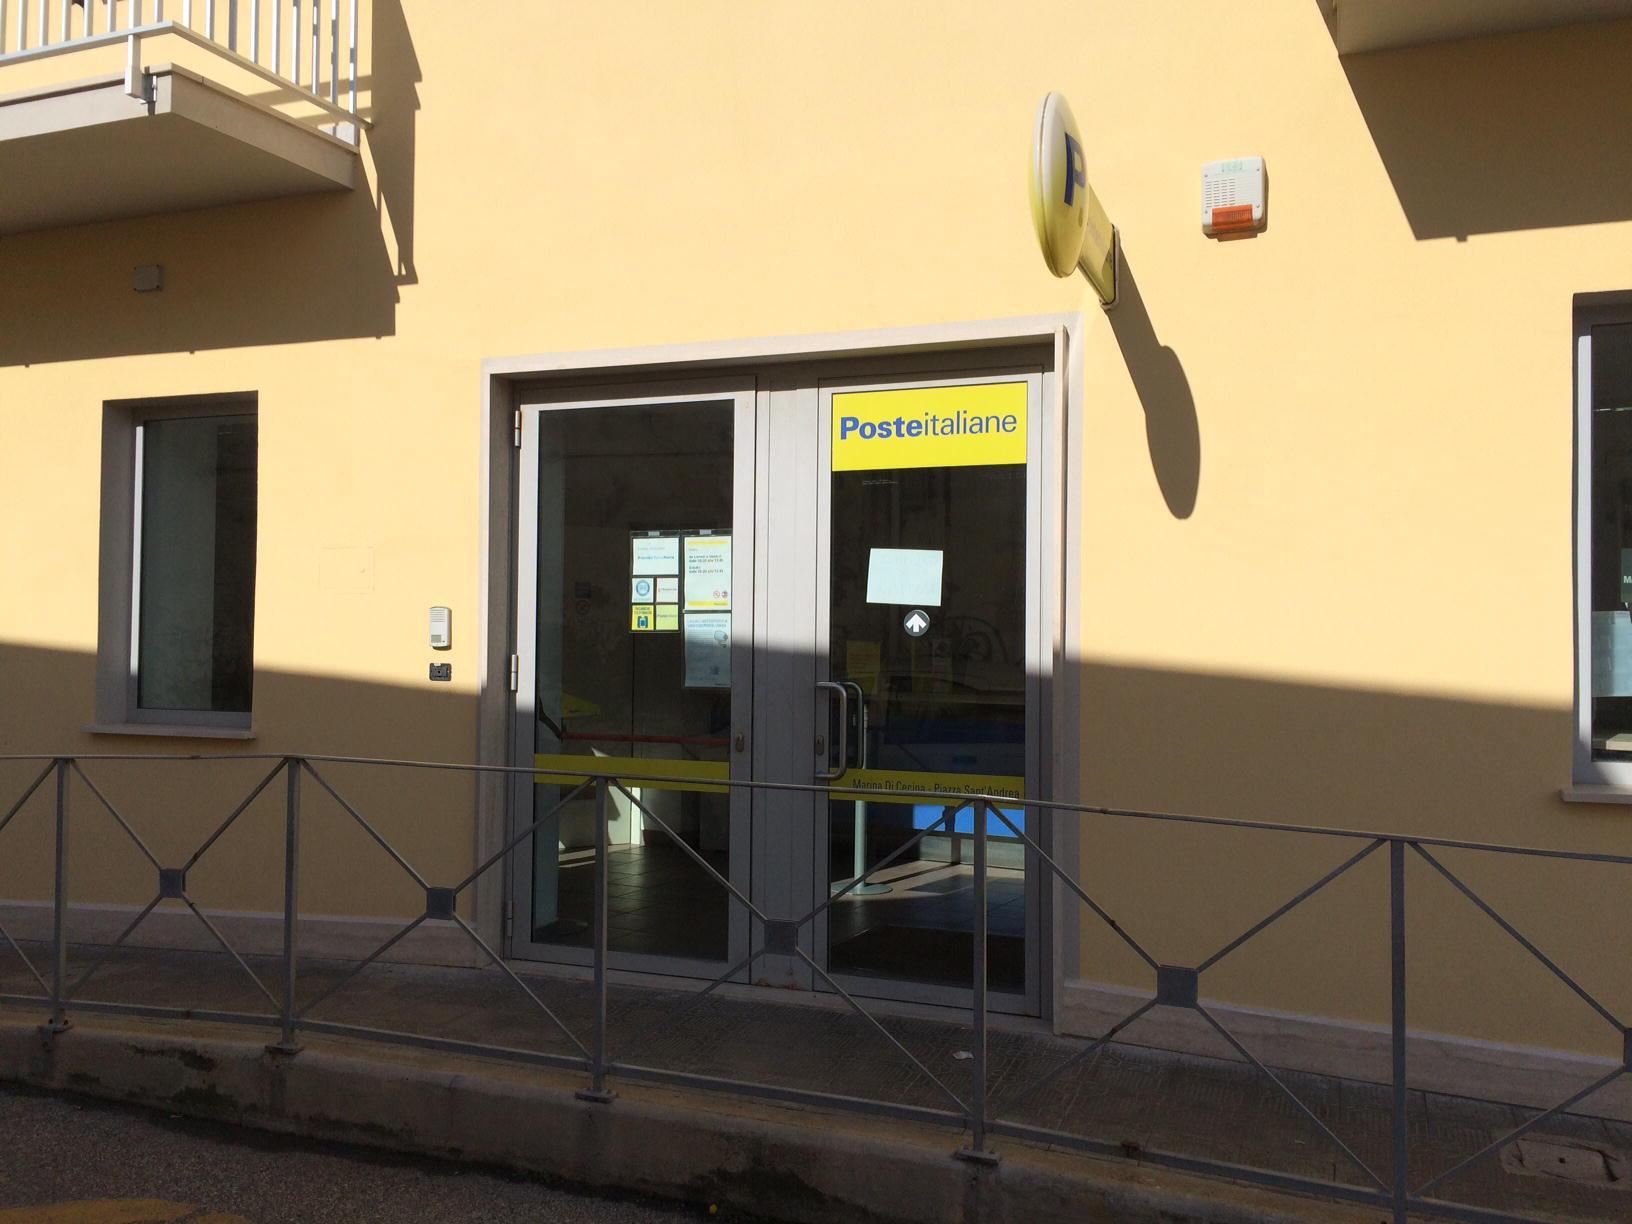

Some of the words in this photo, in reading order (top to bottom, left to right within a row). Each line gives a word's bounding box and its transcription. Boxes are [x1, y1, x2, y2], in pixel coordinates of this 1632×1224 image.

[840, 410, 1017, 440] Posteitaliane
[885, 780, 894, 791] Di
[897, 780, 926, 792] Cecina
[934, 783, 961, 794] Piazza
